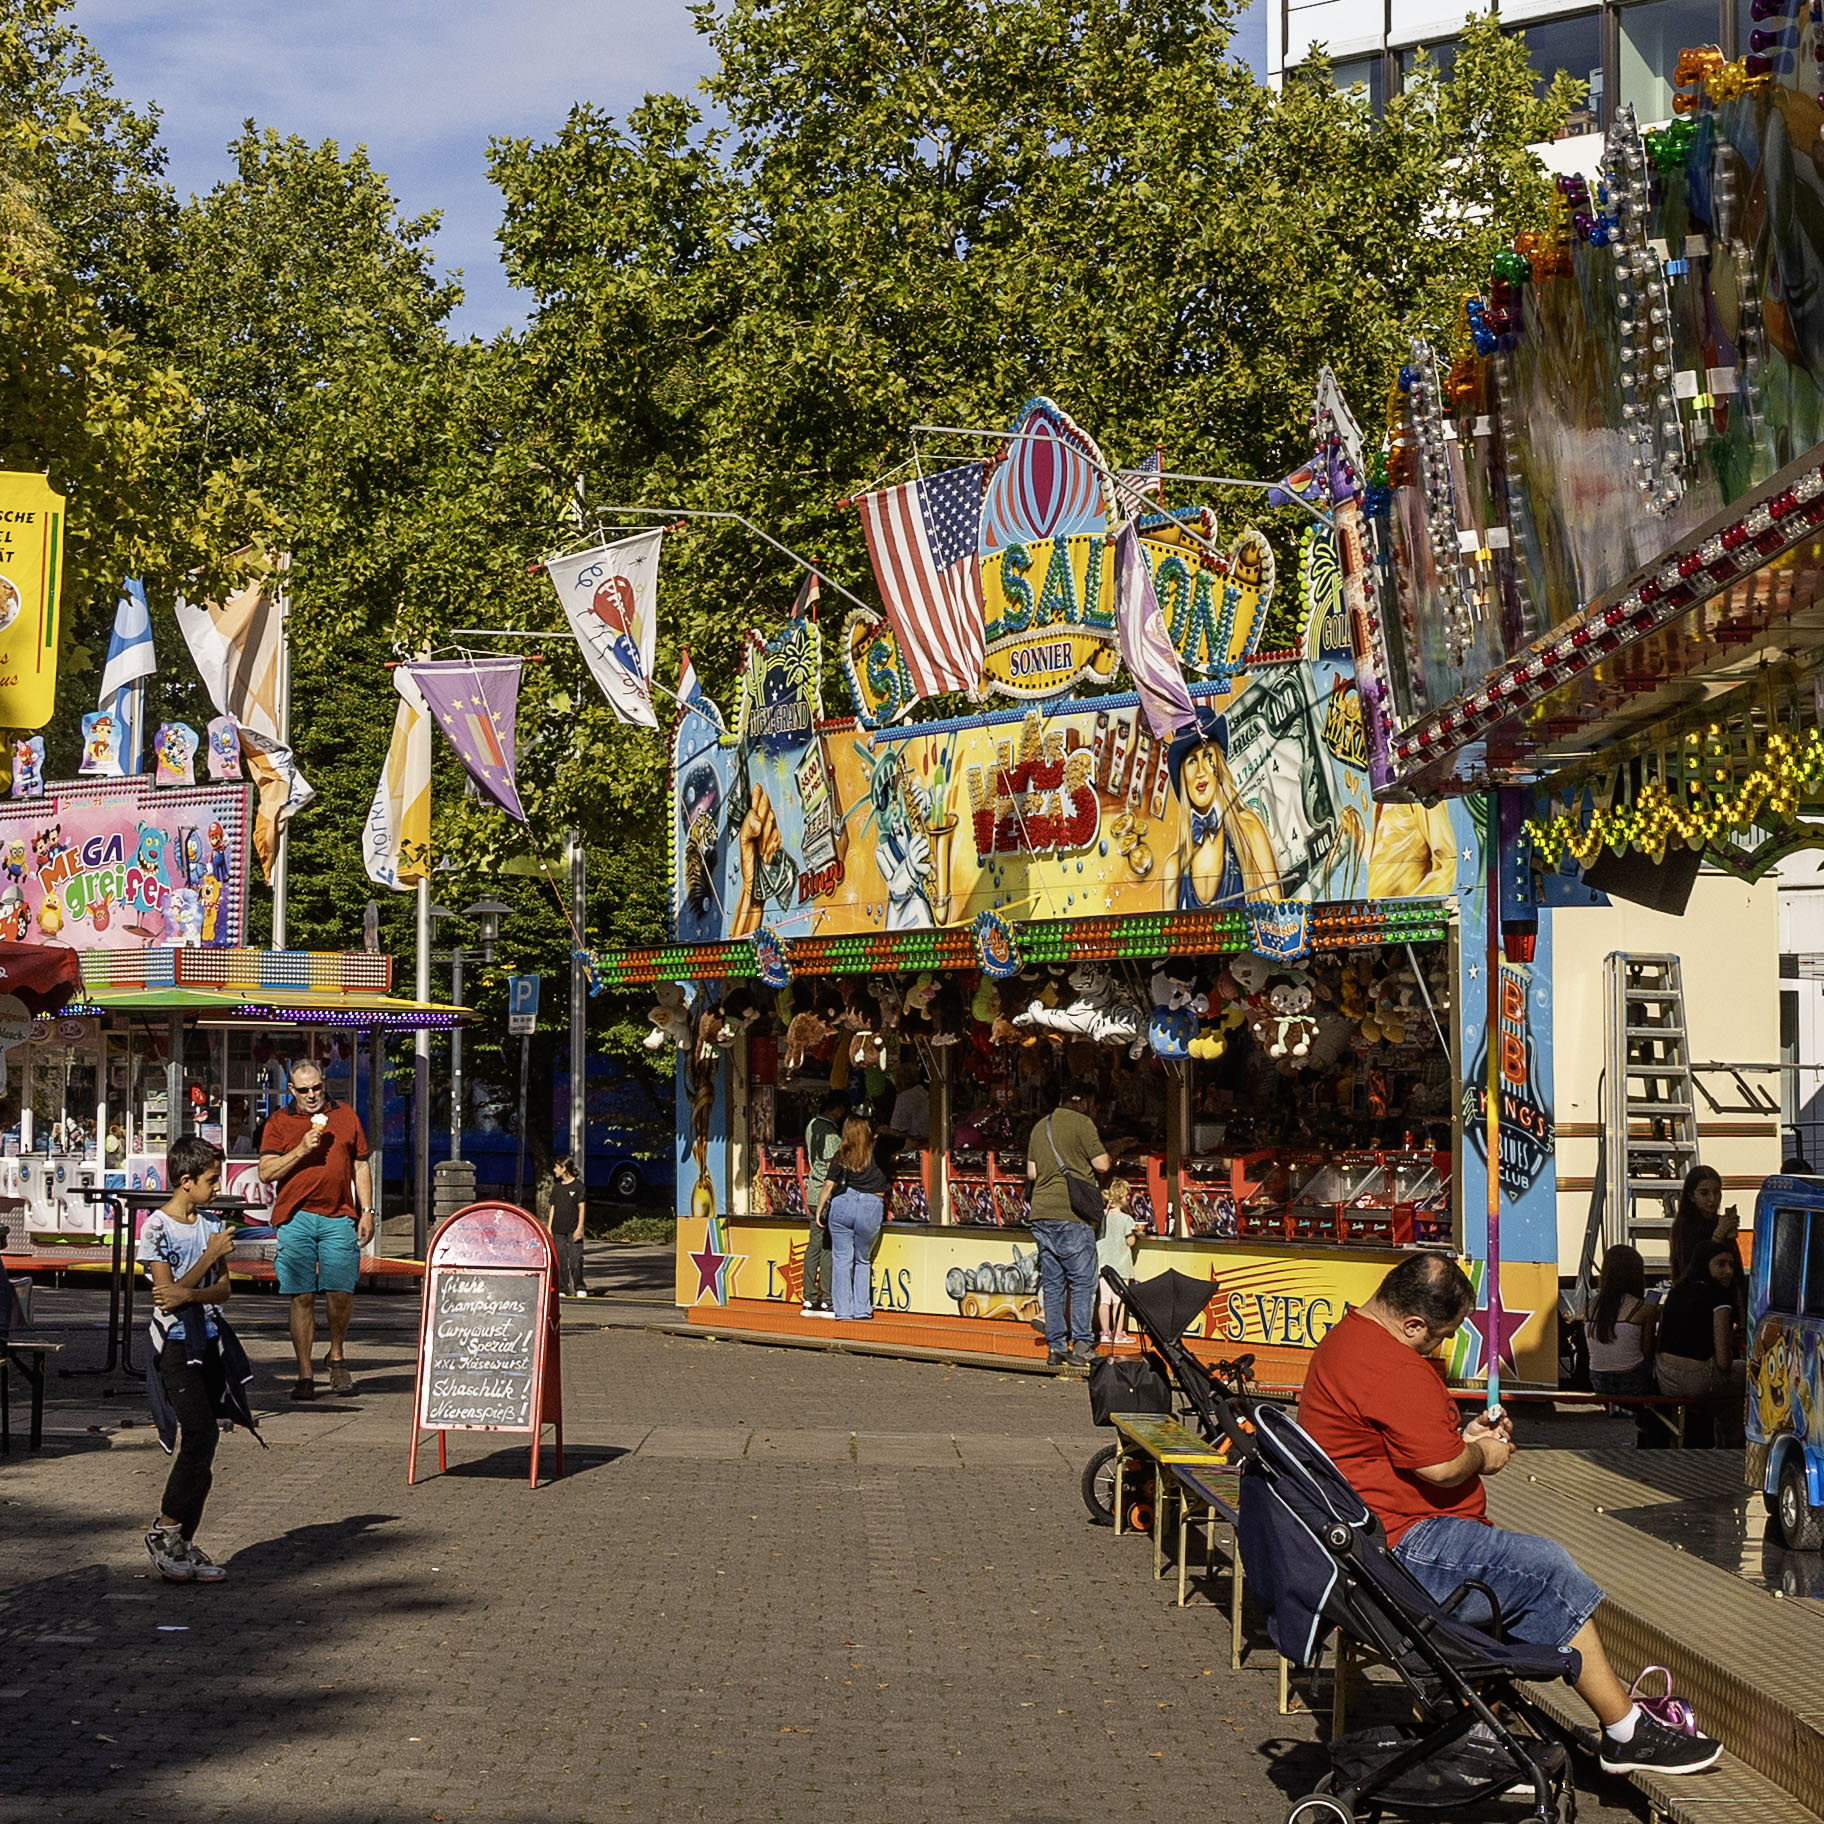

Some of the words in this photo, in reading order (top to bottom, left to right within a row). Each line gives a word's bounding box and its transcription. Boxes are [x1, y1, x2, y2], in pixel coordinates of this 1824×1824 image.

[1009, 640, 1074, 678] SONNIER
[38, 833, 125, 895] MEGA
[798, 860, 845, 904] Bingo
[64, 863, 172, 922] greifer
[517, 981, 532, 1011] P
[1502, 976, 1526, 1025] B
[1502, 1028, 1527, 1086] B
[1479, 1089, 1545, 1138] KNG'S
[237, 1183, 275, 1206] KAS
[1498, 1166, 1529, 1189] CLUB
[441, 1276, 486, 1300] frische
[437, 1317, 511, 1346] Currywurst
